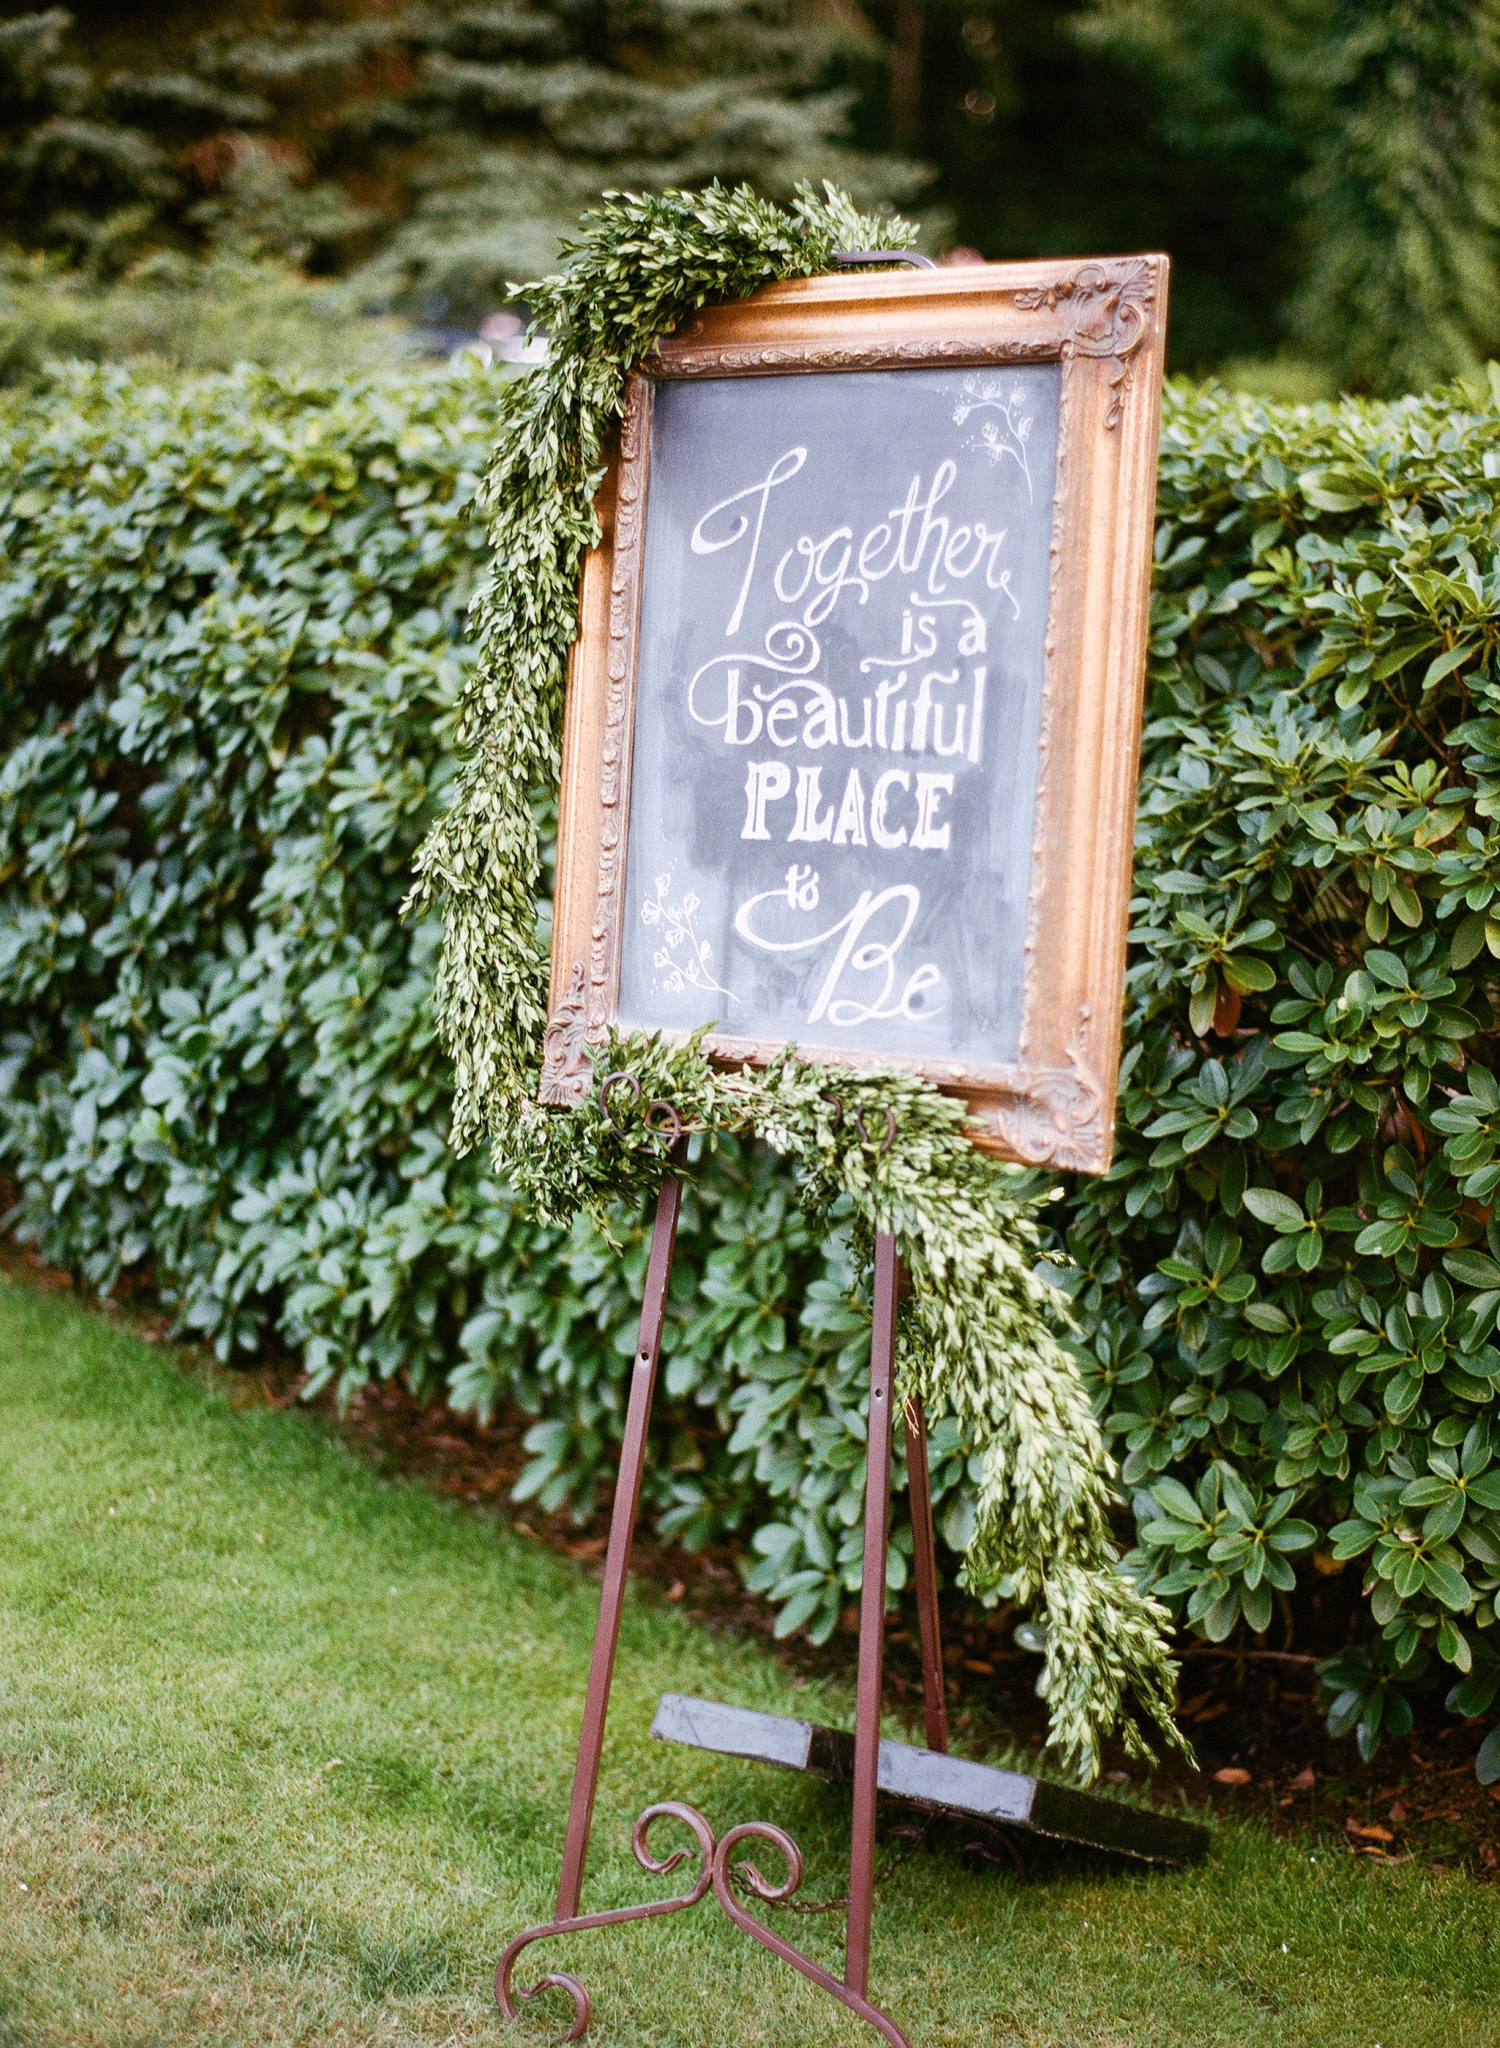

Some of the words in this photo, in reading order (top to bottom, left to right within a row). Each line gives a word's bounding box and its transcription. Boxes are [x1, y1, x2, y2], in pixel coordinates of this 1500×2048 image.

[690, 446, 1020, 637] Together
[688, 621, 987, 763] beautiful
[740, 760, 955, 851] PLACE
[734, 884, 946, 1027] Be
[784, 864, 820, 911] to
